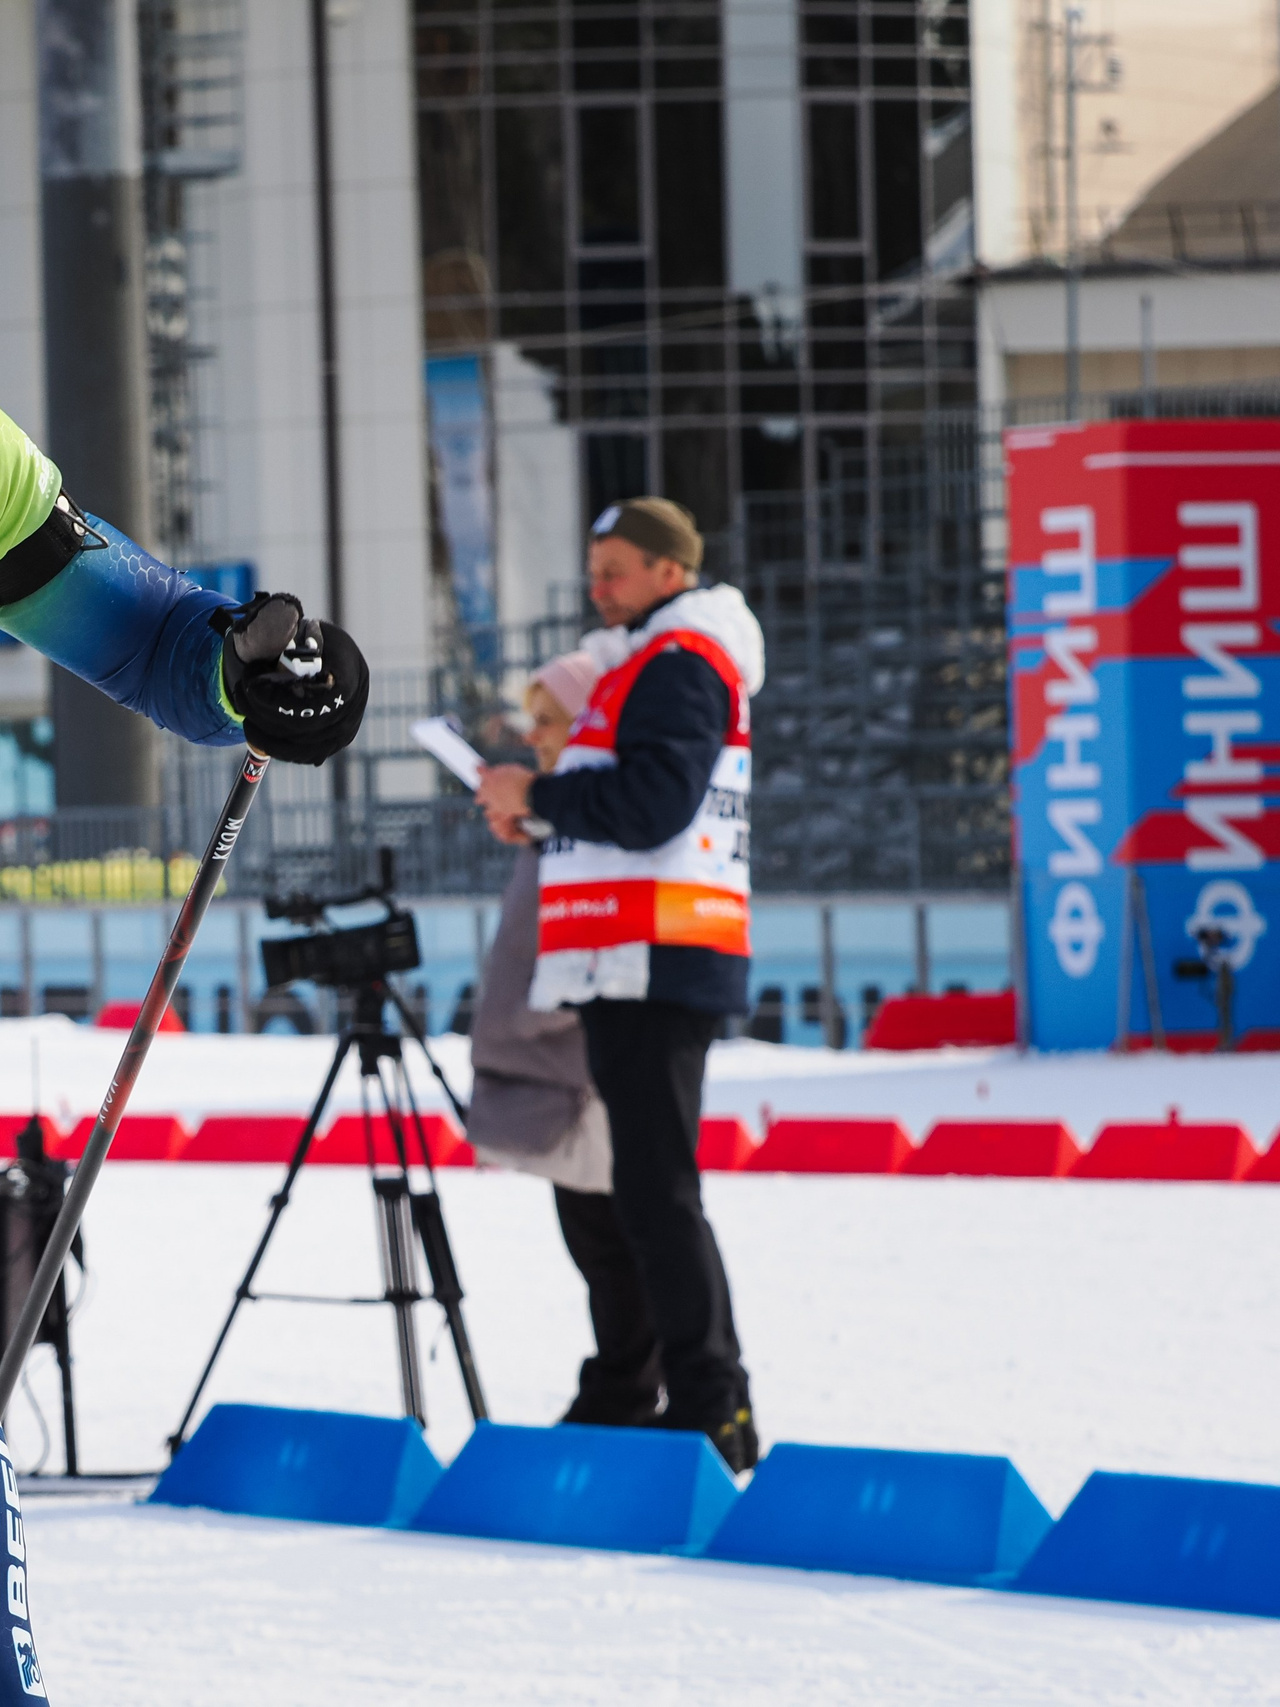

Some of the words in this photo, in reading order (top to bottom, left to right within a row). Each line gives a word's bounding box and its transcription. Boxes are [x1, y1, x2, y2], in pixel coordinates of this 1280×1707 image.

[278, 693, 345, 719] MOAX
[1040, 504, 1106, 978] ФИНИШ
[1177, 500, 1267, 973] ФИНИШ
[211, 817, 245, 860] MOAX
